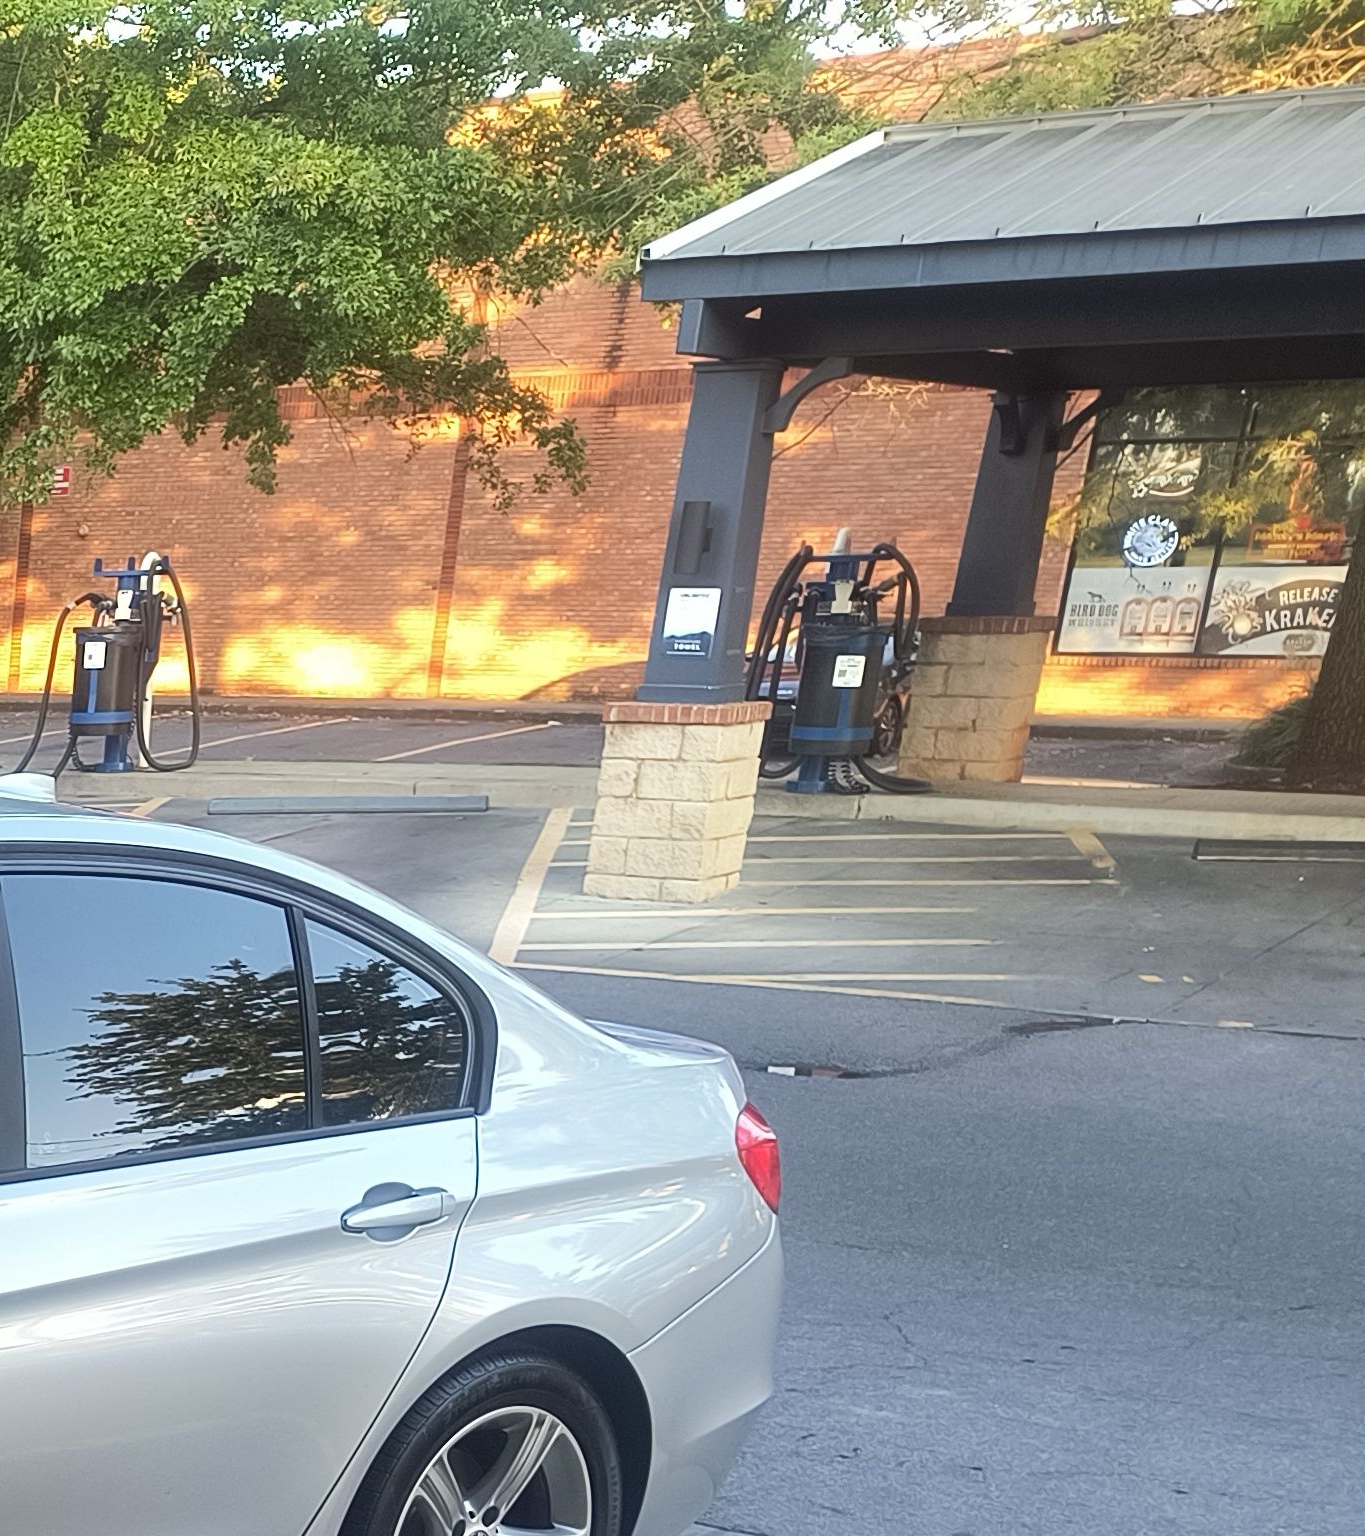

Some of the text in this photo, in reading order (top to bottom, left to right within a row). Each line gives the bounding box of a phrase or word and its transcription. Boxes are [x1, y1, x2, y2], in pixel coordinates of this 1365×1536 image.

[1279, 586, 1339, 606] RELEASE
[1069, 603, 1119, 617] BIRD DOG
